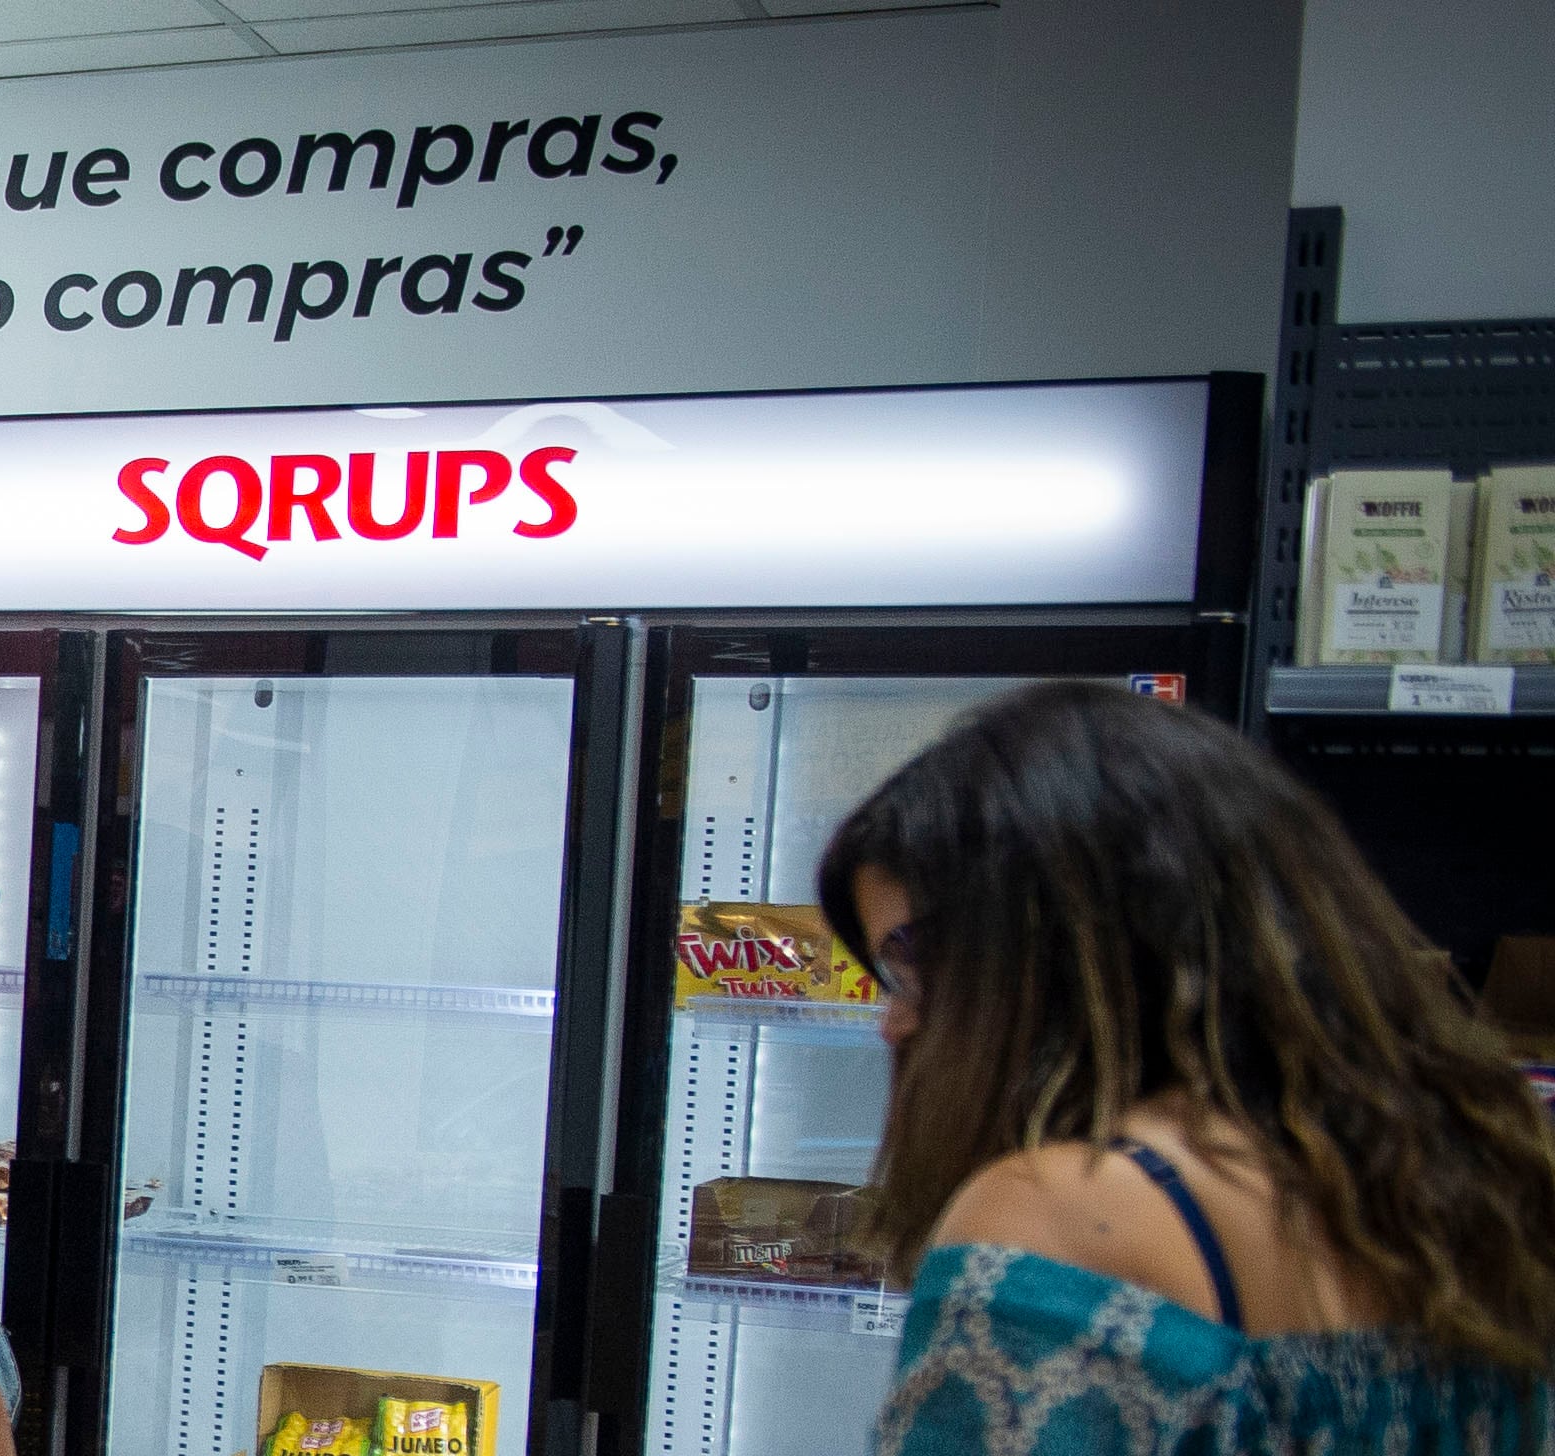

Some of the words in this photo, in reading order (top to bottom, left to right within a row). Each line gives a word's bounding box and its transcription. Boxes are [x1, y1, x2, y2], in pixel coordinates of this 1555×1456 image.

[159, 109, 679, 209] compras,
[44, 224, 585, 342] compras”
[111, 446, 579, 562] SQRUPS
[389, 1435, 463, 1455] JUMBO
